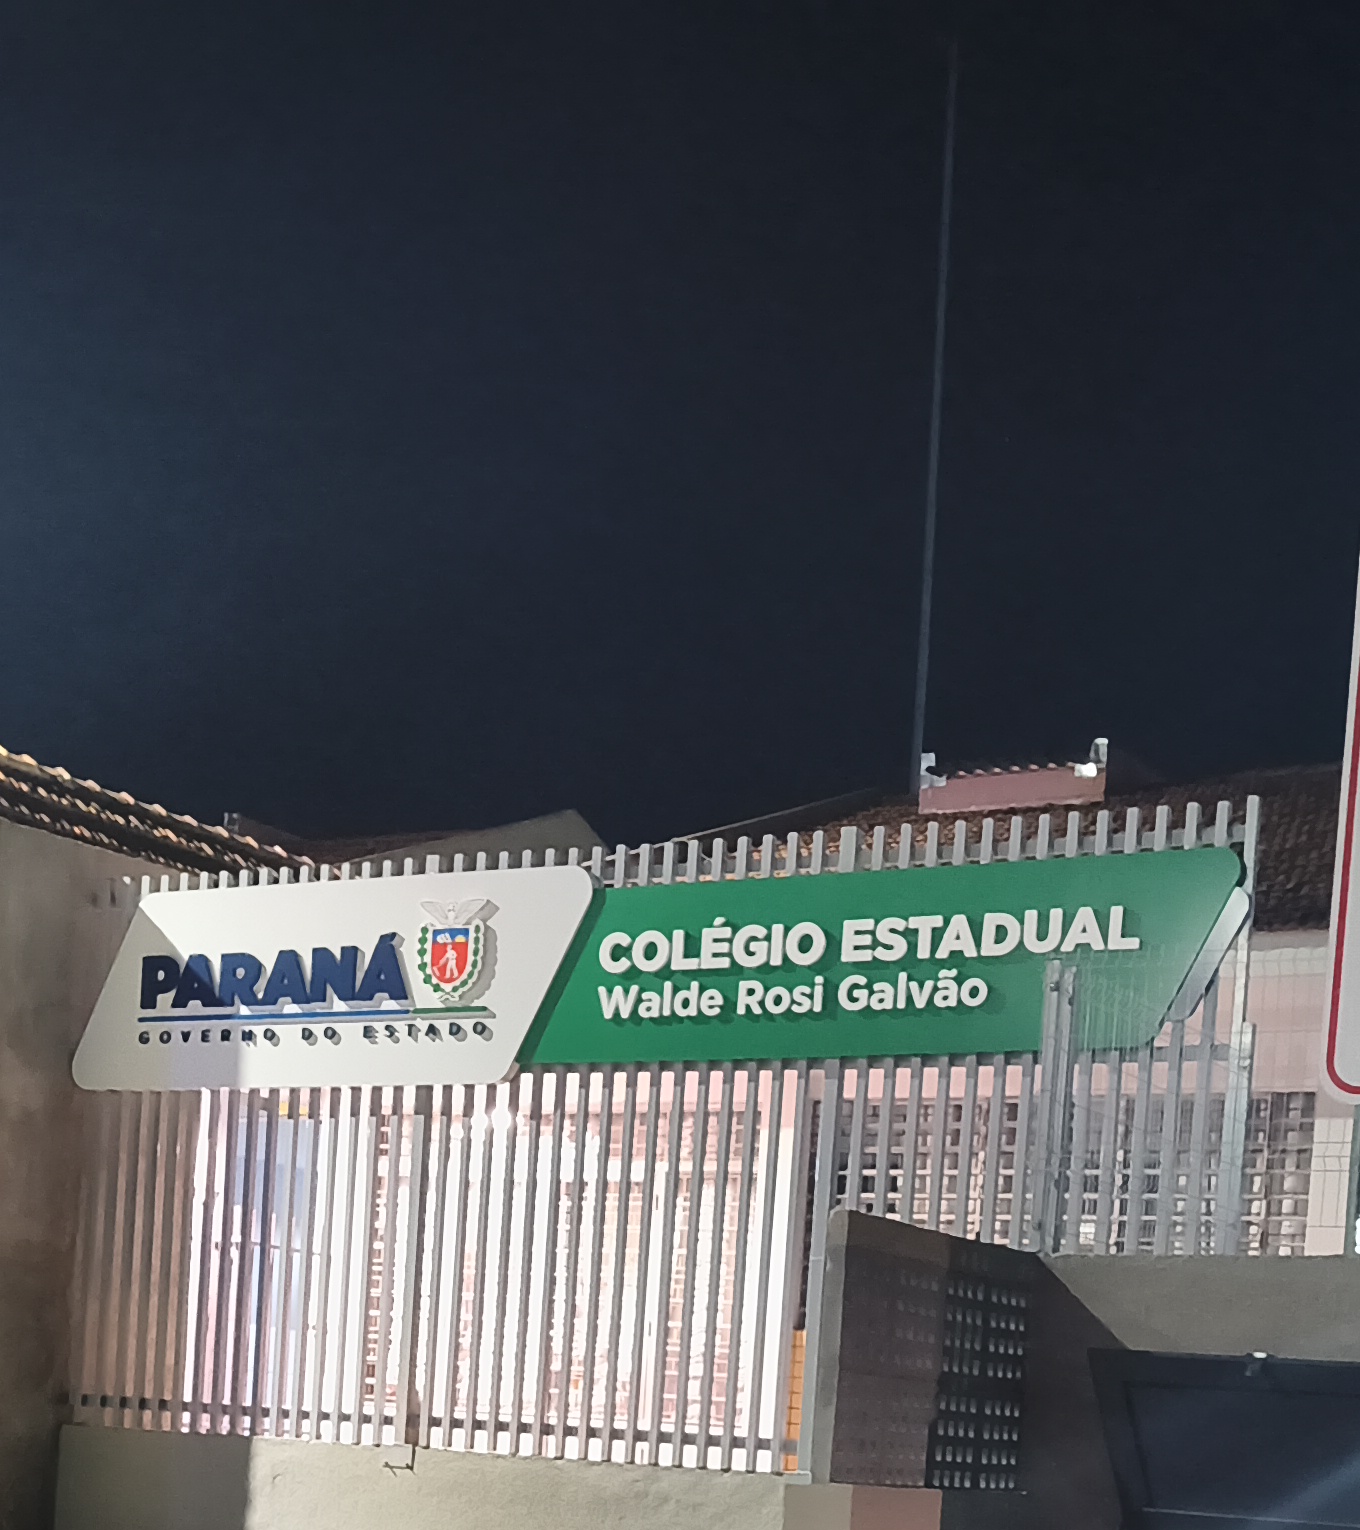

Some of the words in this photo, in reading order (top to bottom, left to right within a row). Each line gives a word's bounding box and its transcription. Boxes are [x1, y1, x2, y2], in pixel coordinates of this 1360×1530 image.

[598, 917, 826, 975] COLÉGIO
[840, 905, 1140, 963] ESTADUAL
[139, 932, 409, 1010] PARANÁ
[597, 982, 724, 1020] Walde
[736, 976, 824, 1016] Rosi
[838, 968, 988, 1012] Galvão
[138, 1027, 276, 1046] GOVERNO
[301, 1025, 338, 1042] DO
[362, 1020, 488, 1039] ESTADO
